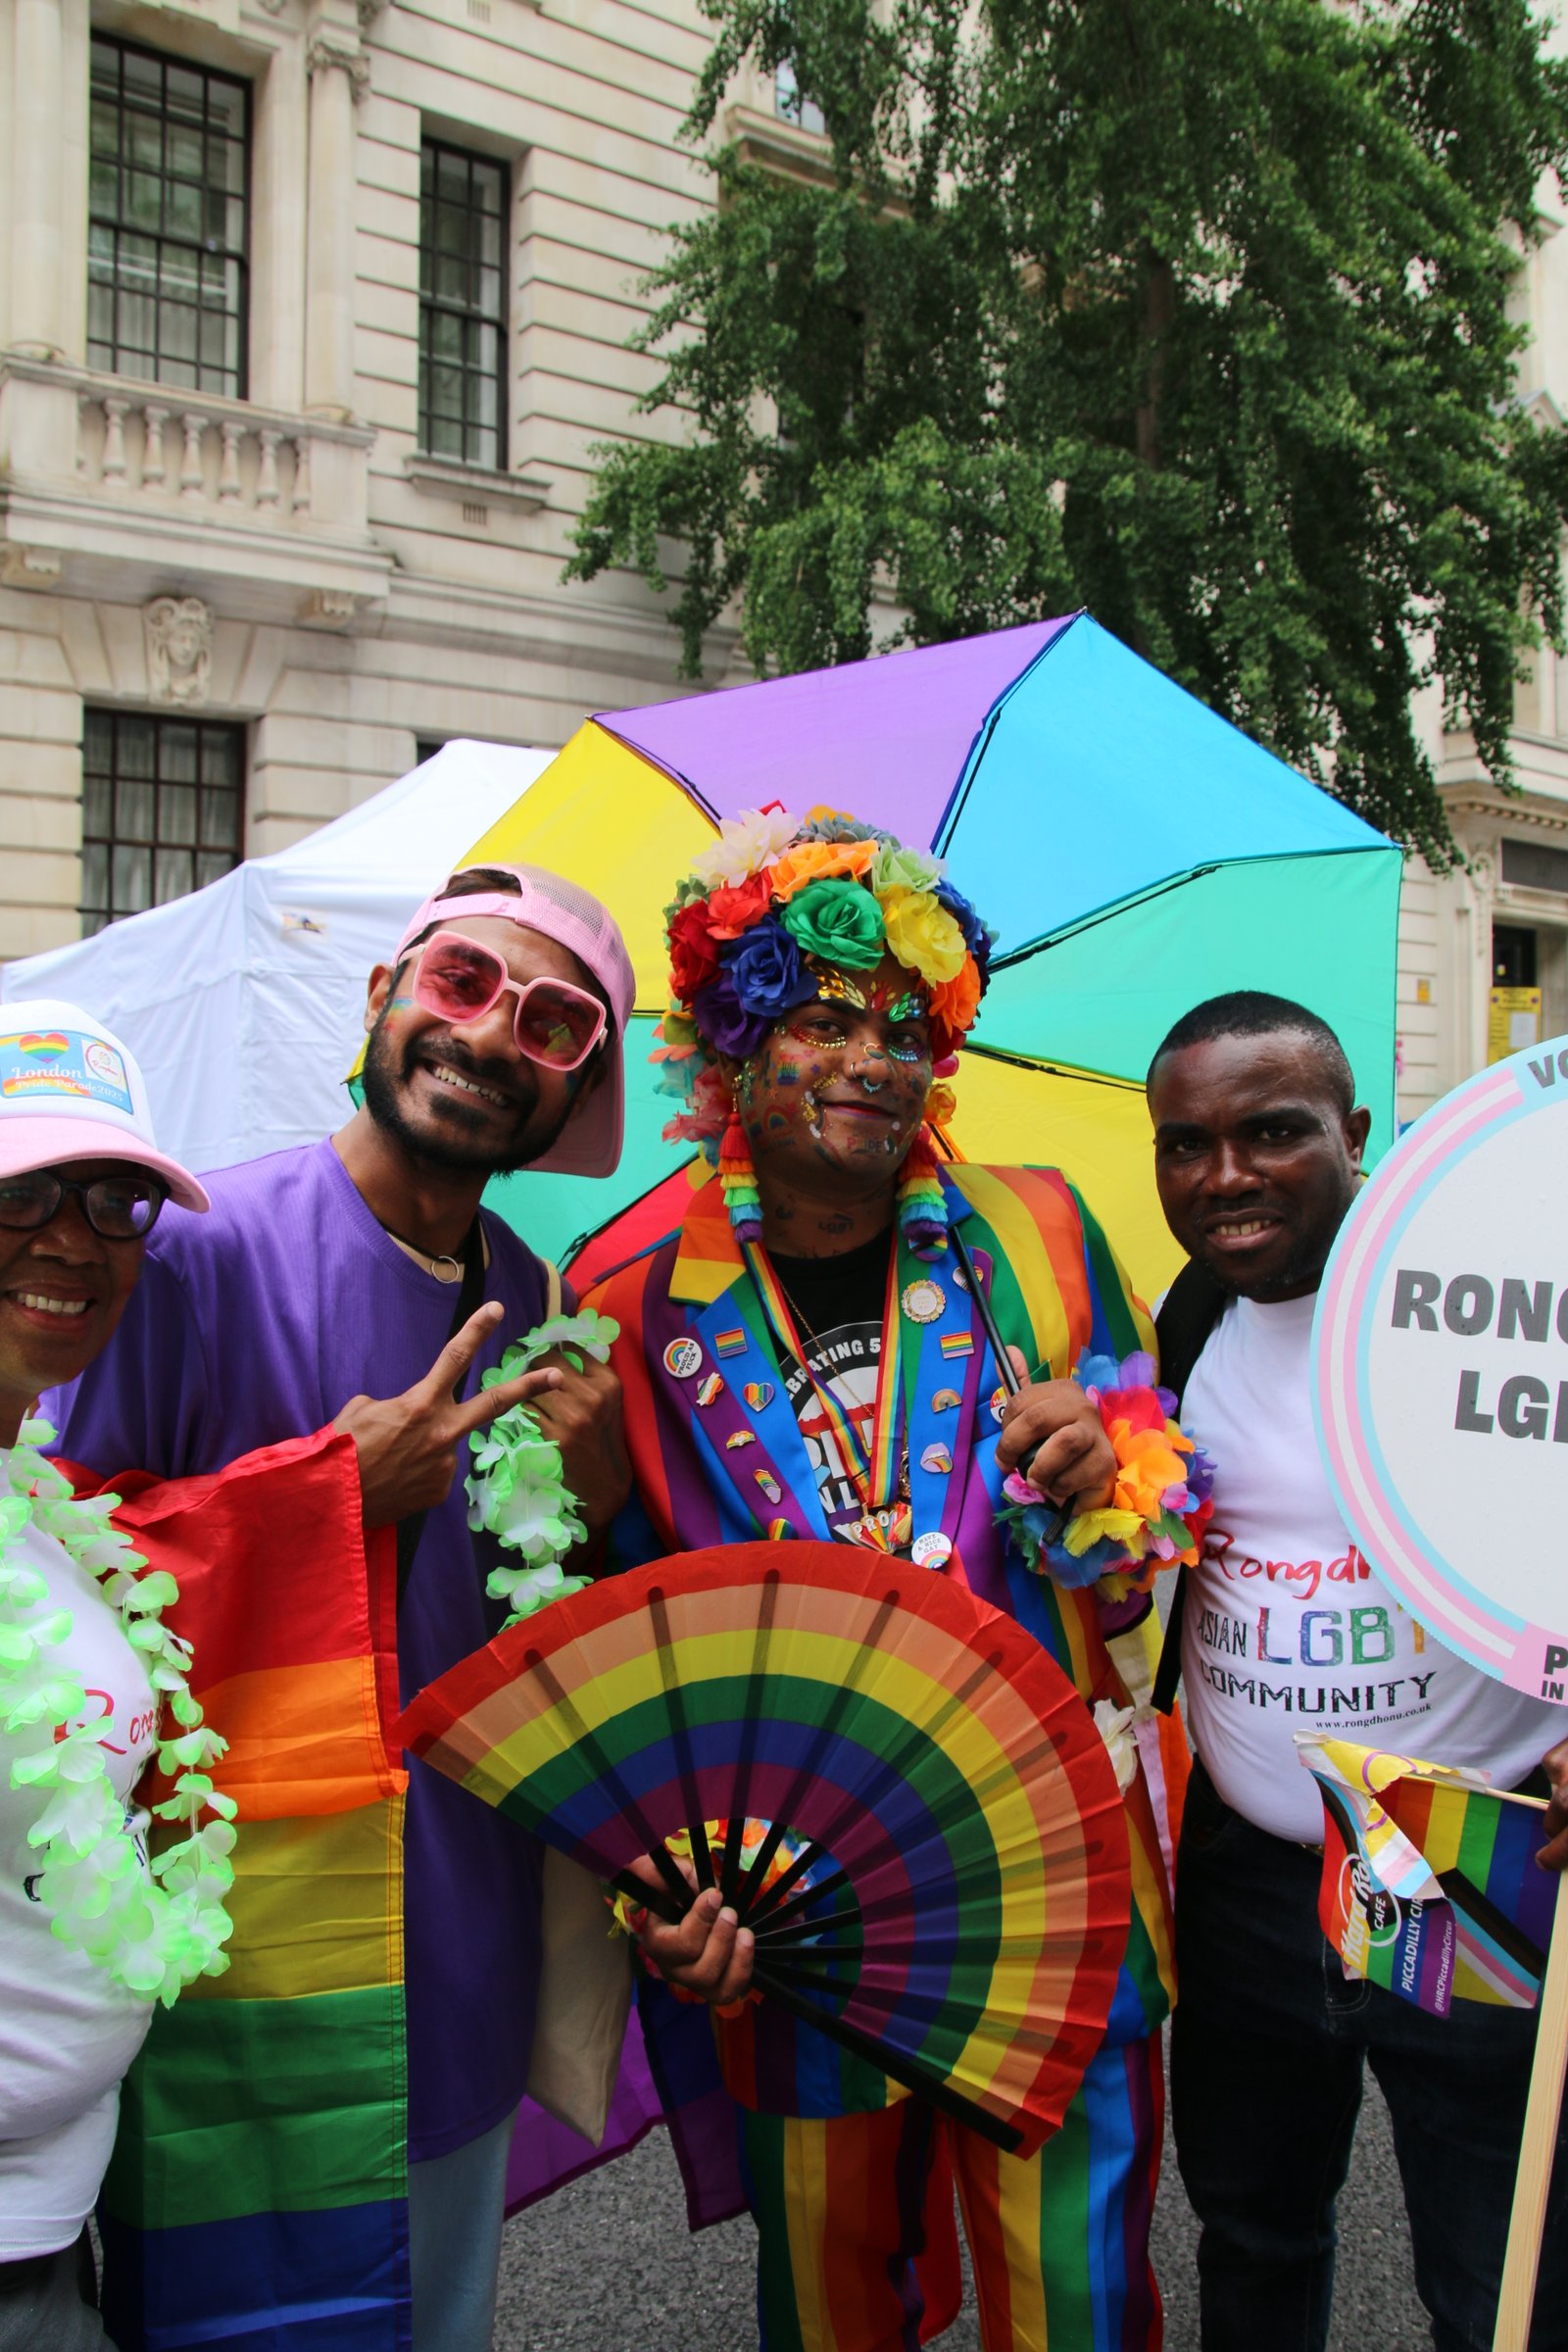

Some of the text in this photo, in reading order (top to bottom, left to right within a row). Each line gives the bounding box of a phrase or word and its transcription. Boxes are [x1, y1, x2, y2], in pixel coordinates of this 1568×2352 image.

[12, 1064, 83, 1080] London
[16, 1080, 50, 1090] Pride
[1392, 1269, 1568, 1346] RON
[1198, 1609, 1248, 1658] ASIAN
[1200, 1658, 1437, 1714] COMMUNITY
[1541, 1680, 1564, 1700] IN
[1316, 1703, 1432, 1728] www.rongdhonu.co.uk
[1374, 1895, 1386, 1931] CAFE
[1401, 1919, 1421, 1992] PICCADILLY
[1434, 1920, 1452, 2012] @HRCPiccadillyCircus
